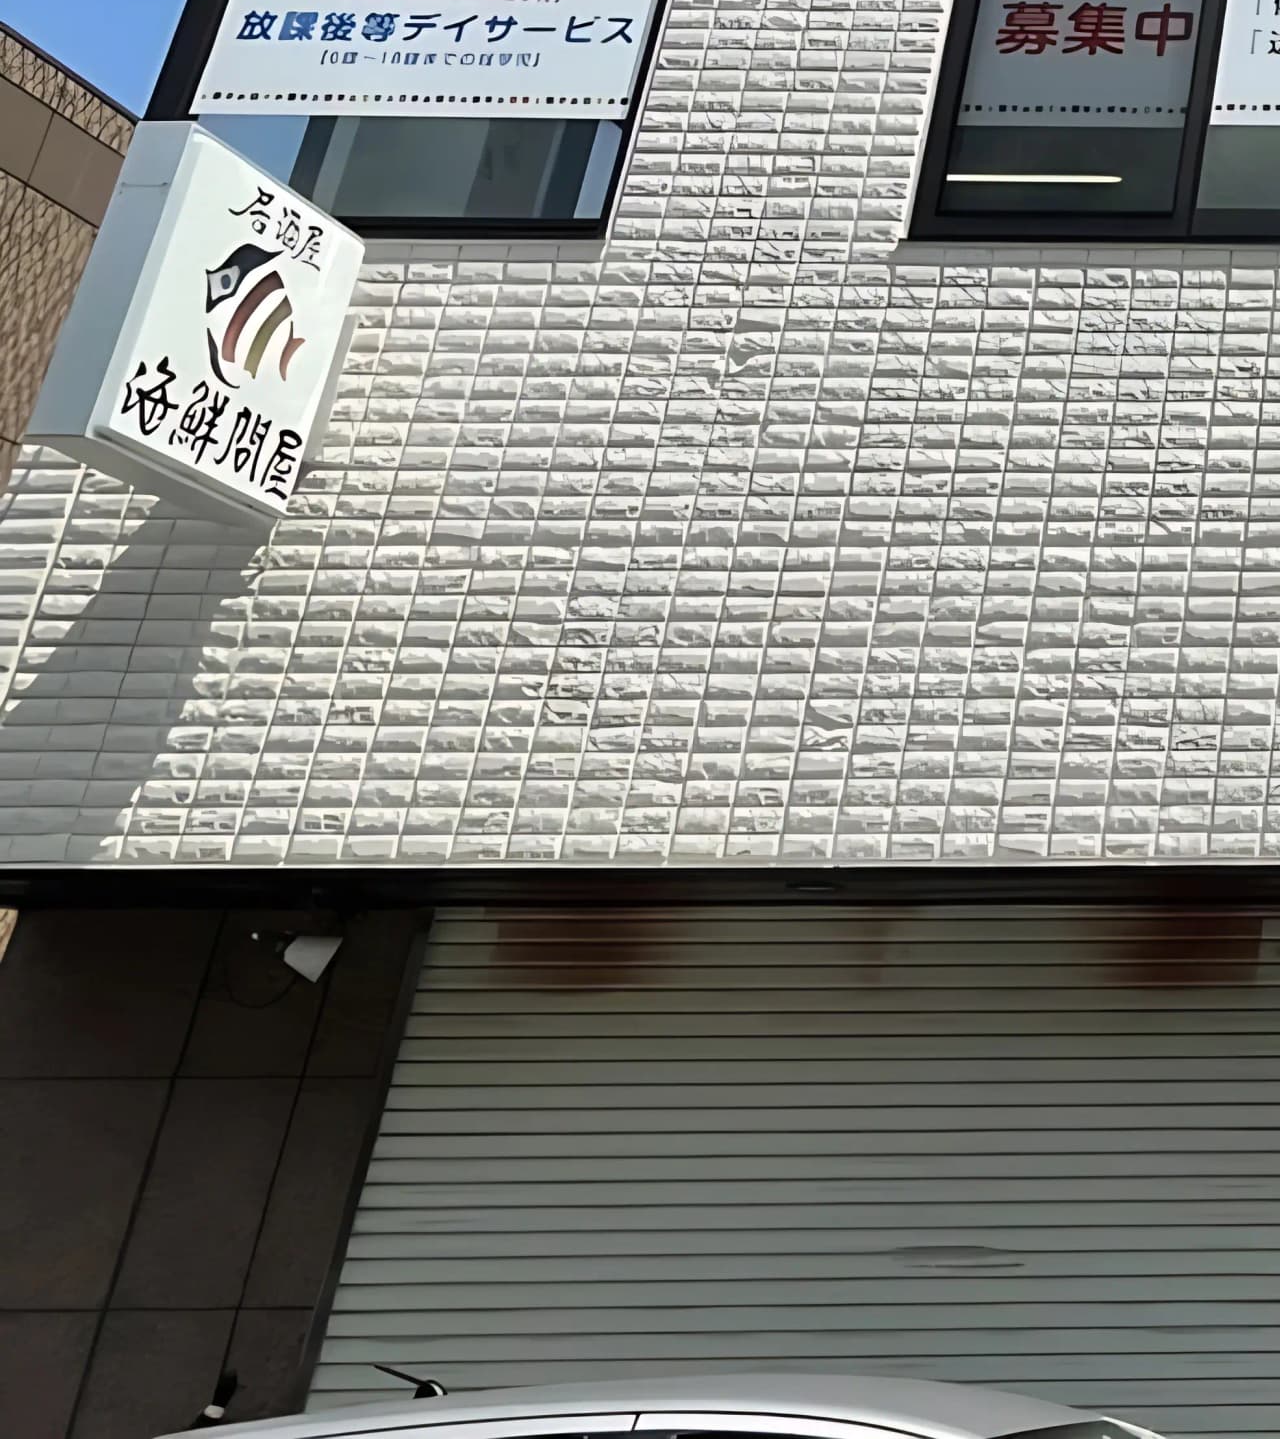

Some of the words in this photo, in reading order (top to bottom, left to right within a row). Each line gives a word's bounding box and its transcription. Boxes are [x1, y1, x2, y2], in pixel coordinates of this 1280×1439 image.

[236, 10, 636, 46] 放課後等デイサービス
[996, 1, 1194, 58] 募集中
[228, 186, 325, 272] 居酒屋
[121, 356, 303, 500] 海鮮問屋
